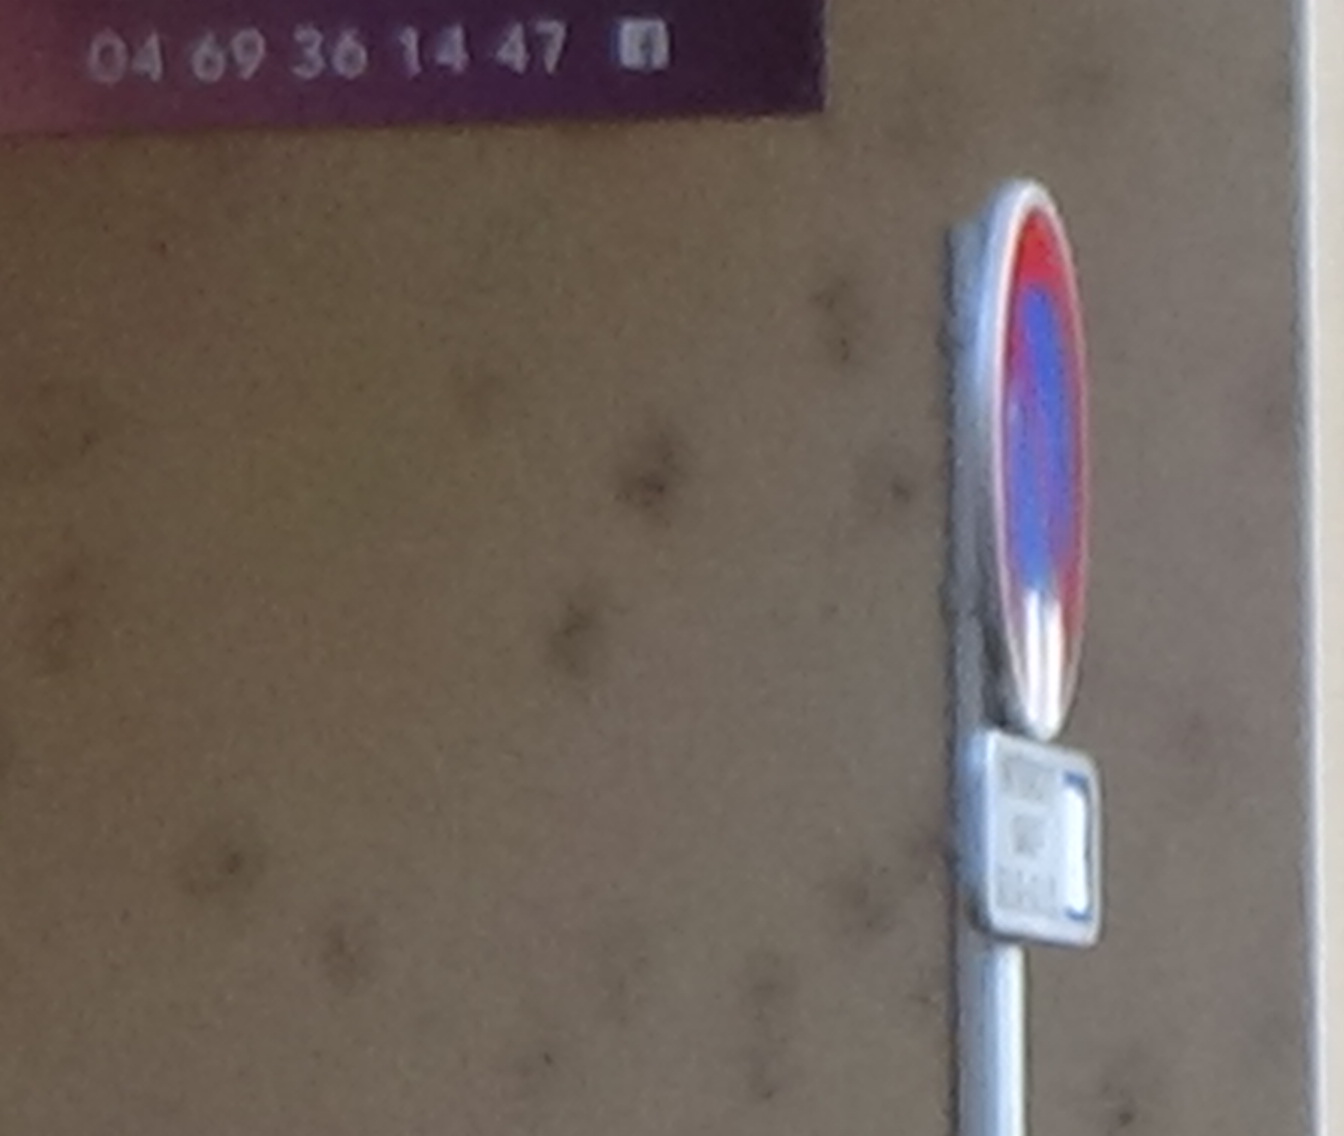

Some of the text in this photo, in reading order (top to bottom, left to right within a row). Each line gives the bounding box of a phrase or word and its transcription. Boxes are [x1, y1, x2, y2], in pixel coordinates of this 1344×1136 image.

[89, 27, 163, 84] 04
[190, 26, 266, 83] 69
[291, 22, 368, 81] 36
[399, 23, 469, 78] 14
[495, 20, 567, 75] 47
